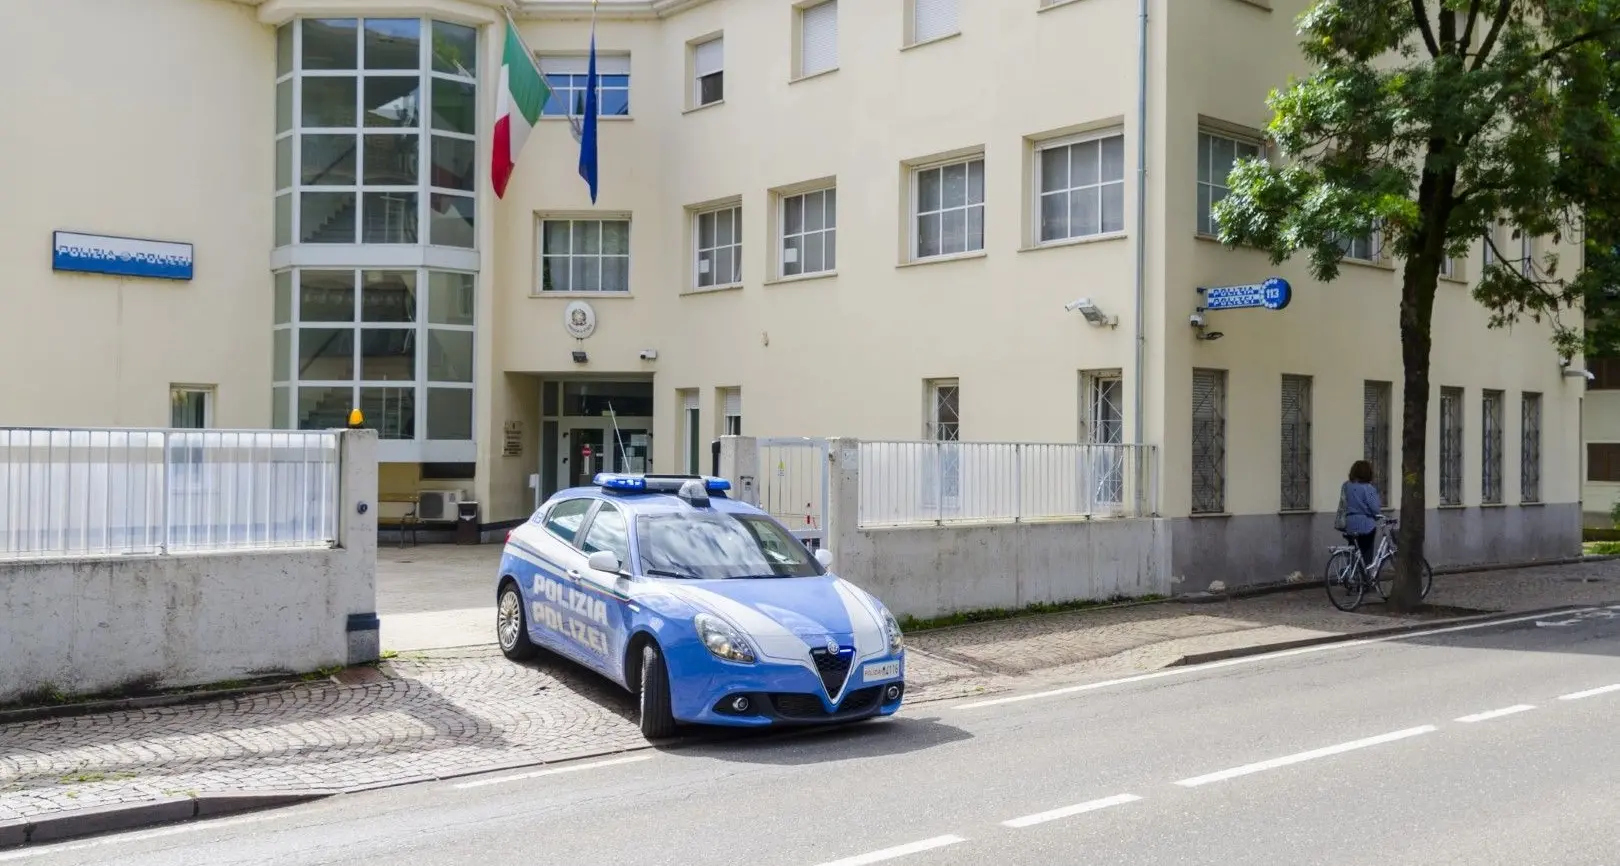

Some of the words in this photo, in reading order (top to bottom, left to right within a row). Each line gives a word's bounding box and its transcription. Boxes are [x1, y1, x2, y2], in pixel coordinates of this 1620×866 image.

[58, 244, 117, 261] POLIZIA
[135, 252, 191, 267] POLIZEI
[1213, 286, 1255, 297] POLIZIA
[1266, 288, 1280, 299] 113
[1213, 296, 1255, 307] POLIZEI
[533, 573, 608, 626] POLIZIA
[532, 601, 609, 656] POLIZEI
